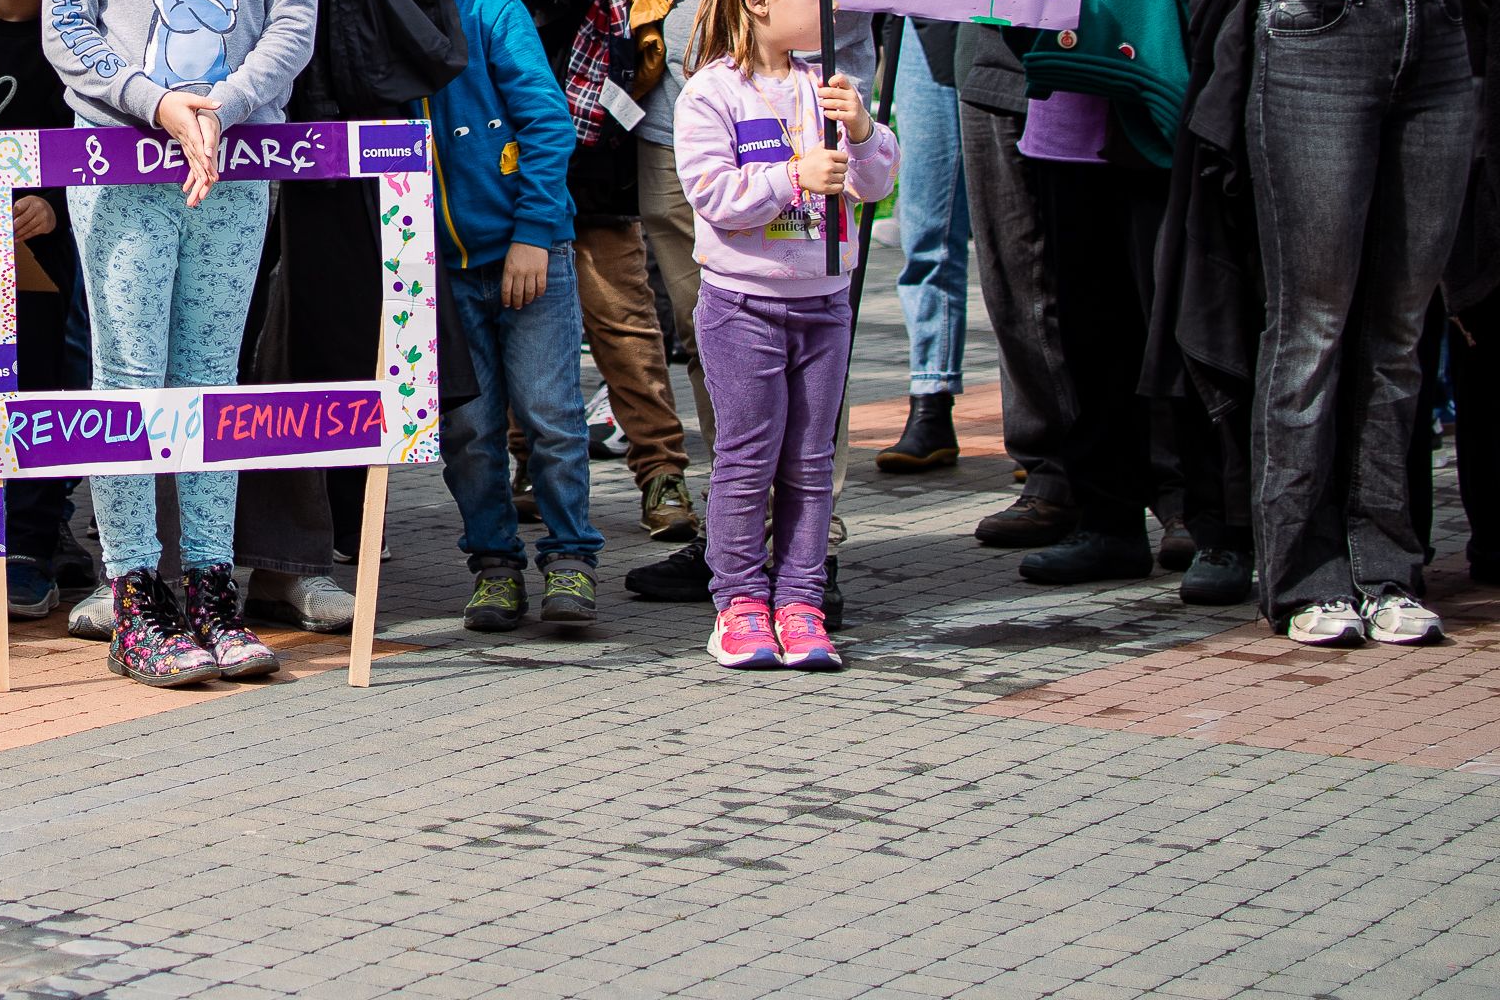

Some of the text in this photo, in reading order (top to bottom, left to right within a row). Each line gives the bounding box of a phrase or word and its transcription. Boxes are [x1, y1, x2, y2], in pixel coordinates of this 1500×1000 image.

[85, 135, 111, 177] 8
[136, 137, 189, 174] DE
[362, 145, 413, 159] comuns
[737, 138, 782, 155] comuns
[4, 394, 388, 451] REVOLUCIÓ FEMINISTA
